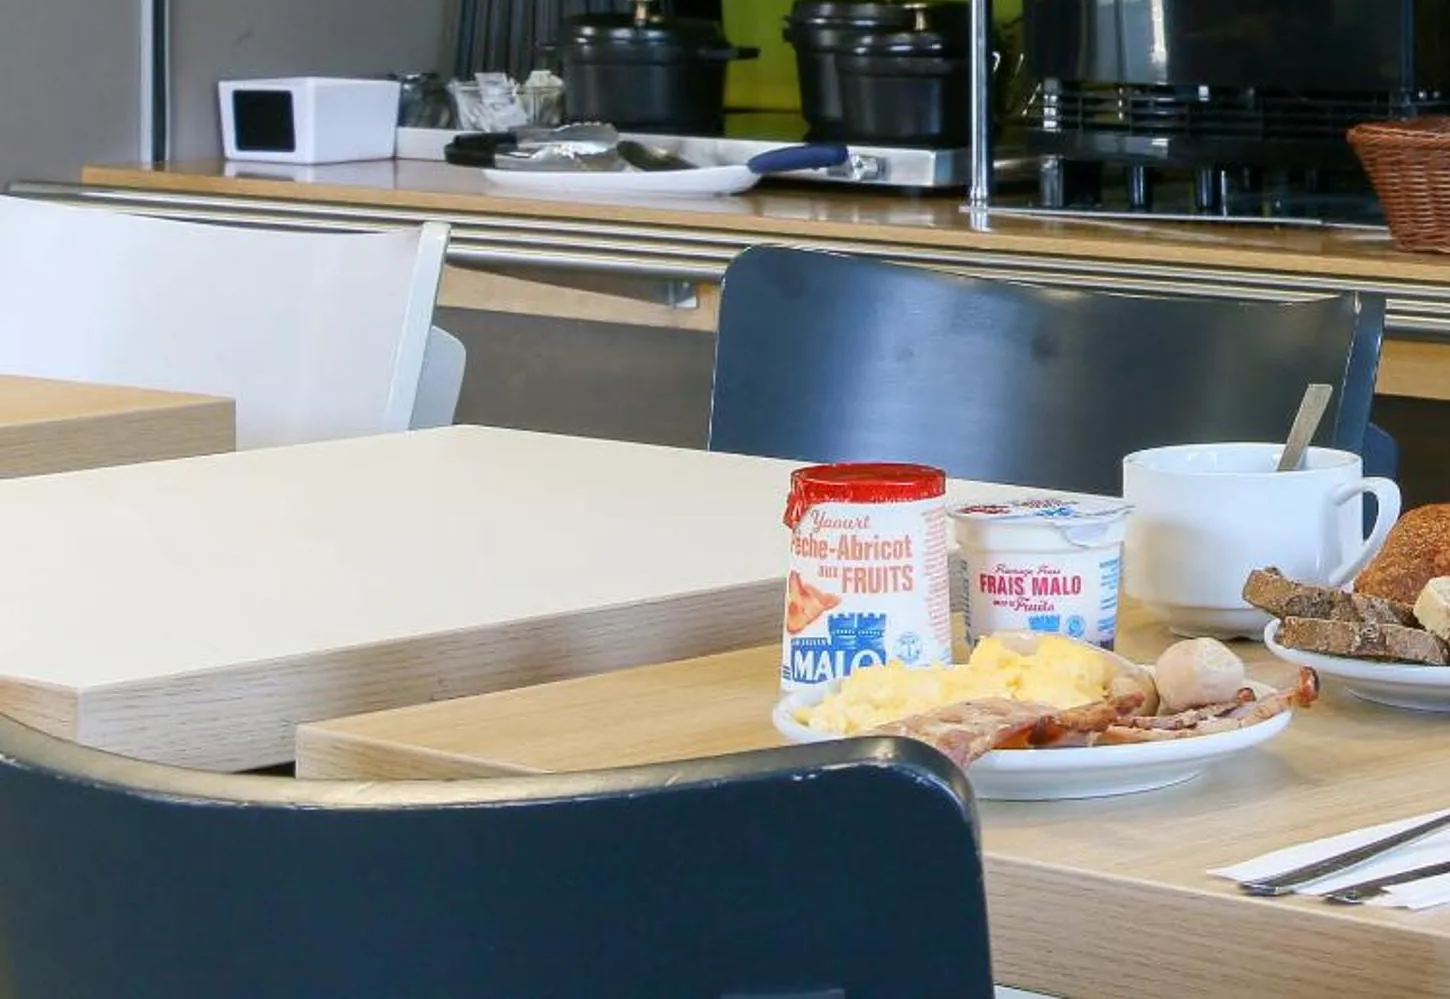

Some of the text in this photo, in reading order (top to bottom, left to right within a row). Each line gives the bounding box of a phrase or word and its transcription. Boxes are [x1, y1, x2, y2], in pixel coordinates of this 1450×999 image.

[810, 509, 870, 533] Yaourt
[818, 564, 914, 595] aux FRUITS
[979, 573, 1082, 596] FRAIS MALO
